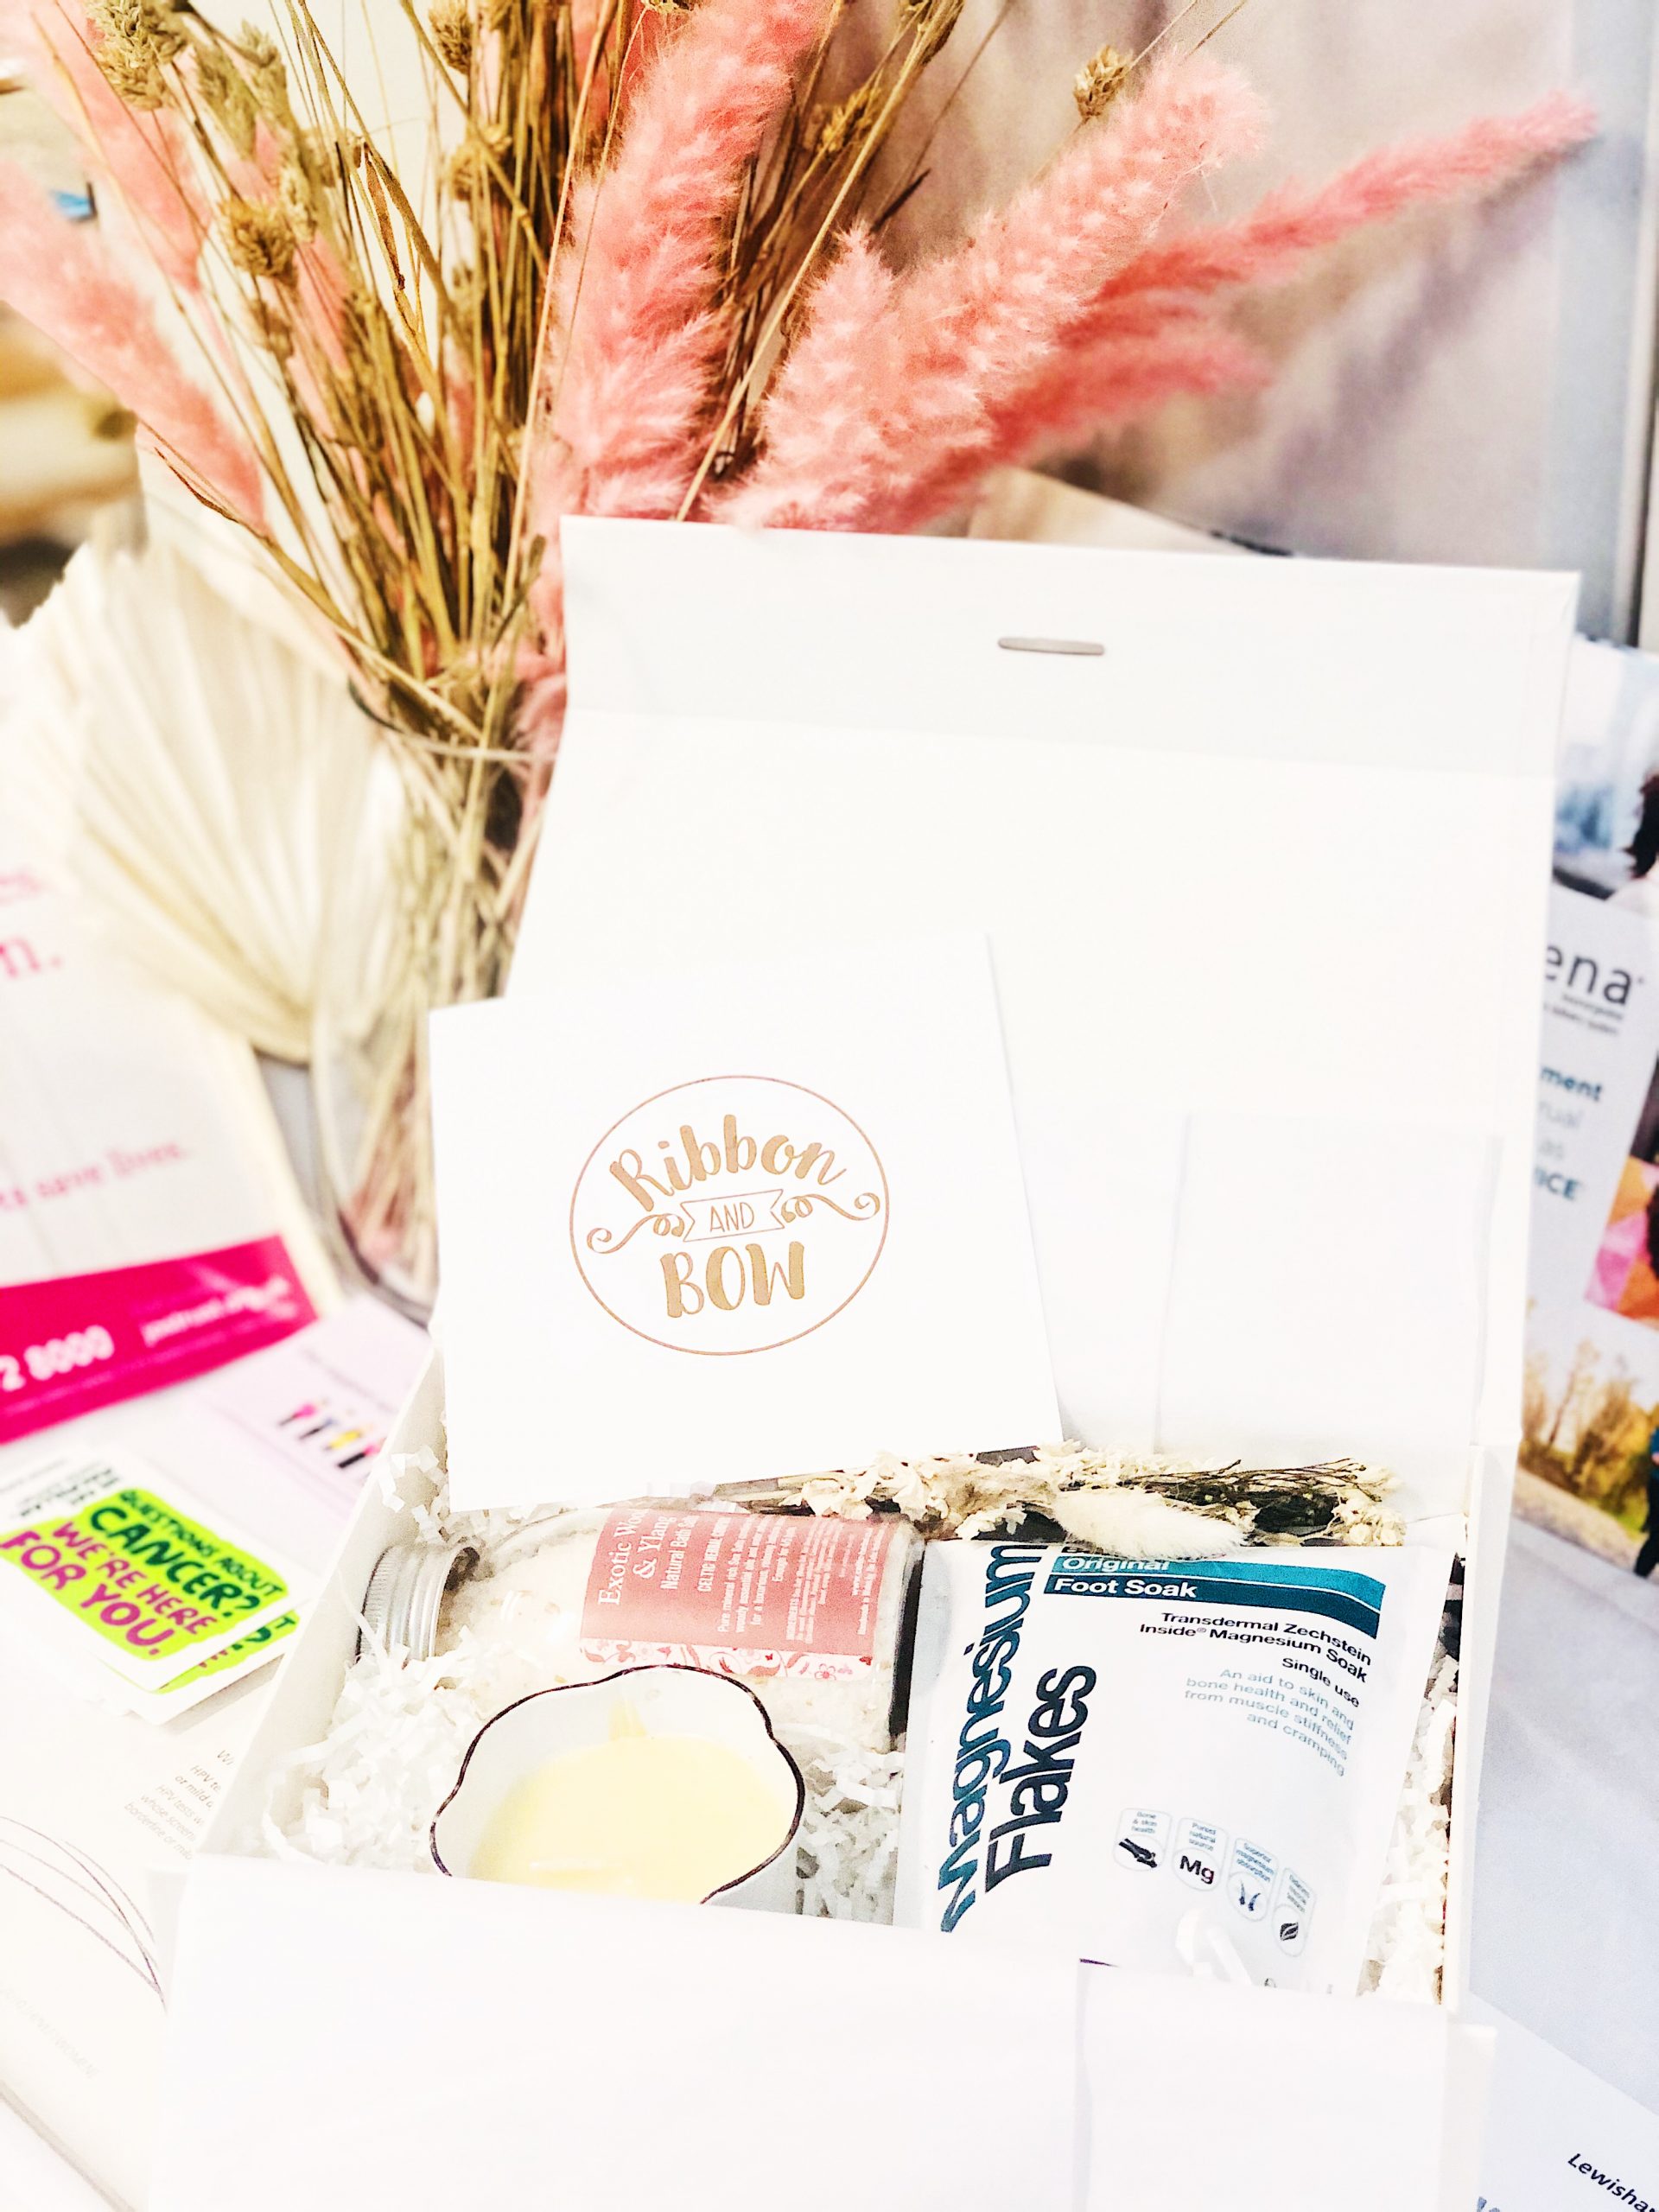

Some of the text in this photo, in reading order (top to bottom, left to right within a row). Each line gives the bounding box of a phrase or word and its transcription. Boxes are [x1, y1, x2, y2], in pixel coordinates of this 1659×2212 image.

[610, 1115, 847, 1211] Ribbon
[709, 1202, 755, 1233] AND
[660, 1241, 805, 1319] BOW
[53, 1521, 218, 1636] WE'RE HERE
[89, 1506, 261, 1618] CANCER?
[214, 1557, 283, 1597] ABOUT
[597, 1541, 632, 1606] Exotic
[632, 1516, 677, 1580] & Ylang
[659, 1549, 686, 1590] Natural
[696, 1563, 716, 1592] CELTIC
[1061, 1556, 1170, 1573] Original
[0, 1530, 175, 1656] FOR YOU.
[1053, 1577, 1198, 1599] Foot Soak
[1161, 1612, 1372, 1667] Transdermal Zechstein
[1210, 1628, 1321, 1655] Magnesium
[1326, 1648, 1368, 1683] Soak
[1186, 1677, 1352, 1746] bone health and relief
[1219, 1669, 1355, 1732] An aid to skin and
[1282, 1657, 1361, 1708] Single use
[938, 1544, 1047, 1933] Magnesium
[1185, 1690, 1348, 1761] from muscle stiffness
[1247, 1713, 1345, 1777] and cramping
[175, 1776, 211, 1802] or mild
[190, 1764, 214, 1783] HPV
[984, 1665, 1096, 1892] Flakes
[1179, 1855, 1215, 1885] Mg
